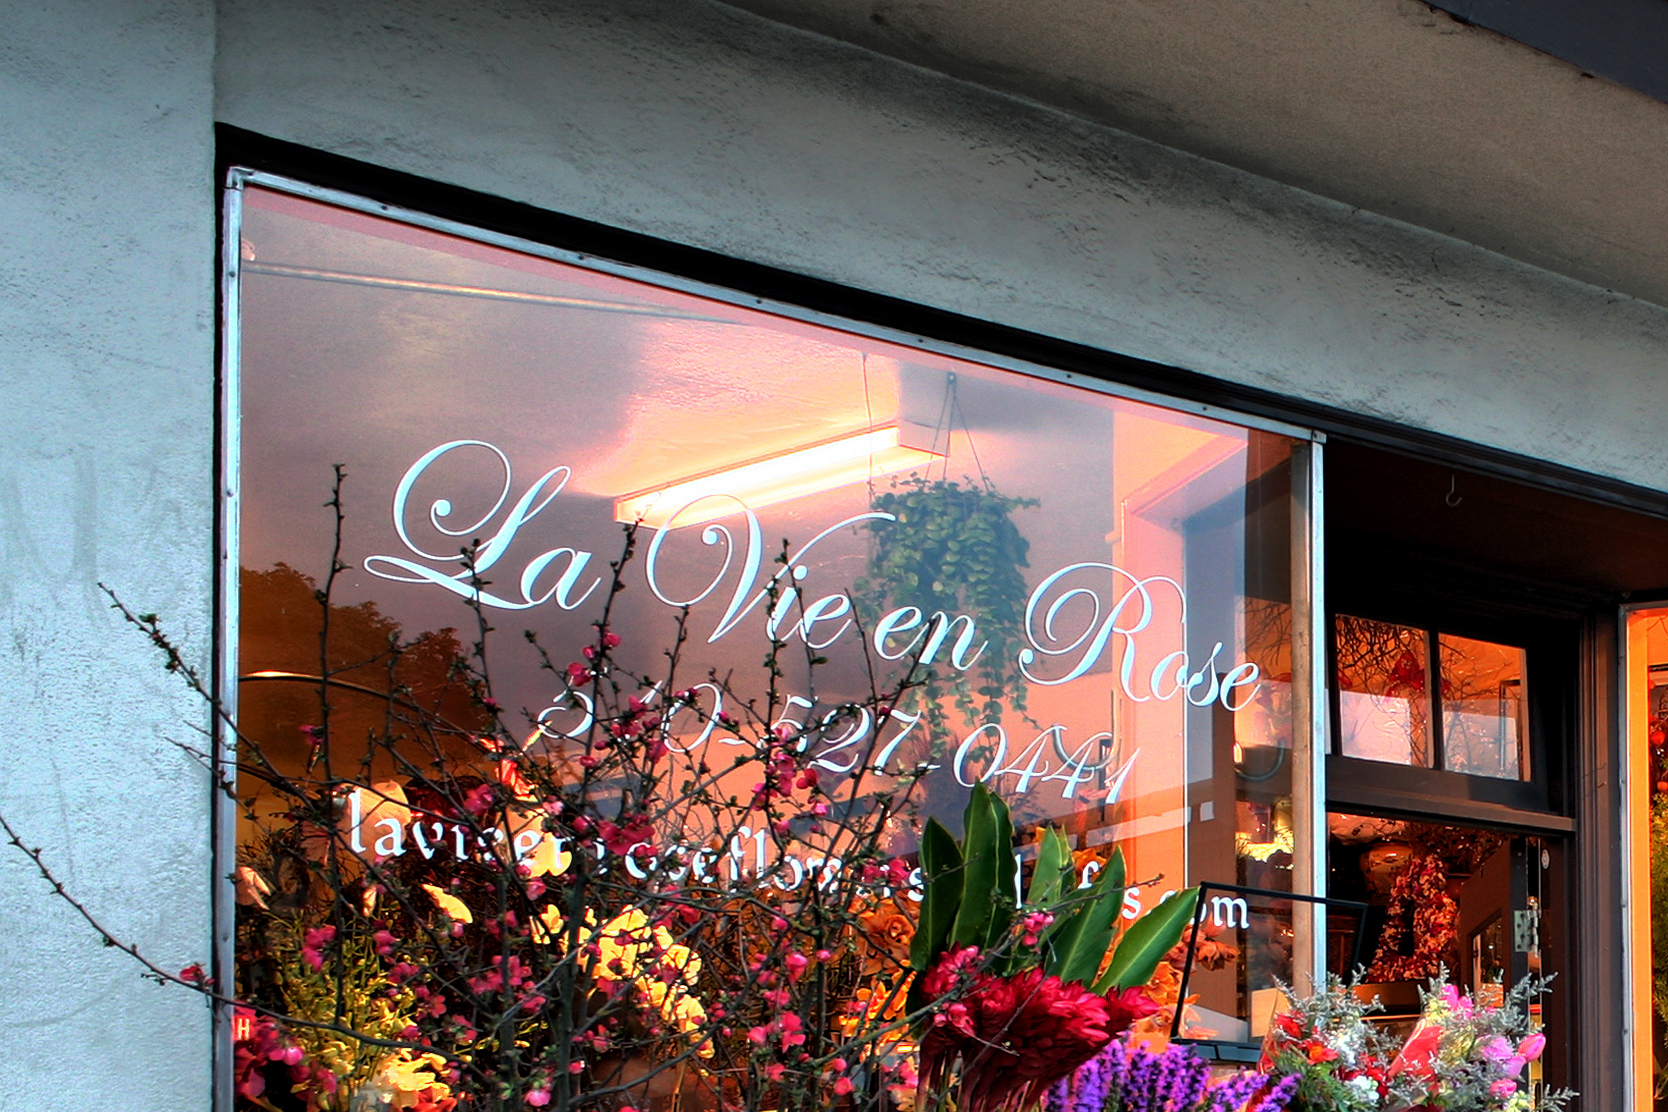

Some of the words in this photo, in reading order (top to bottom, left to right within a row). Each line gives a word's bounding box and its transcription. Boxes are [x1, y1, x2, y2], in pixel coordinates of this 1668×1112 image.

[363, 439, 601, 610] La
[646, 494, 897, 649] Vie
[874, 606, 989, 671] en
[1018, 562, 1261, 712] Rose
